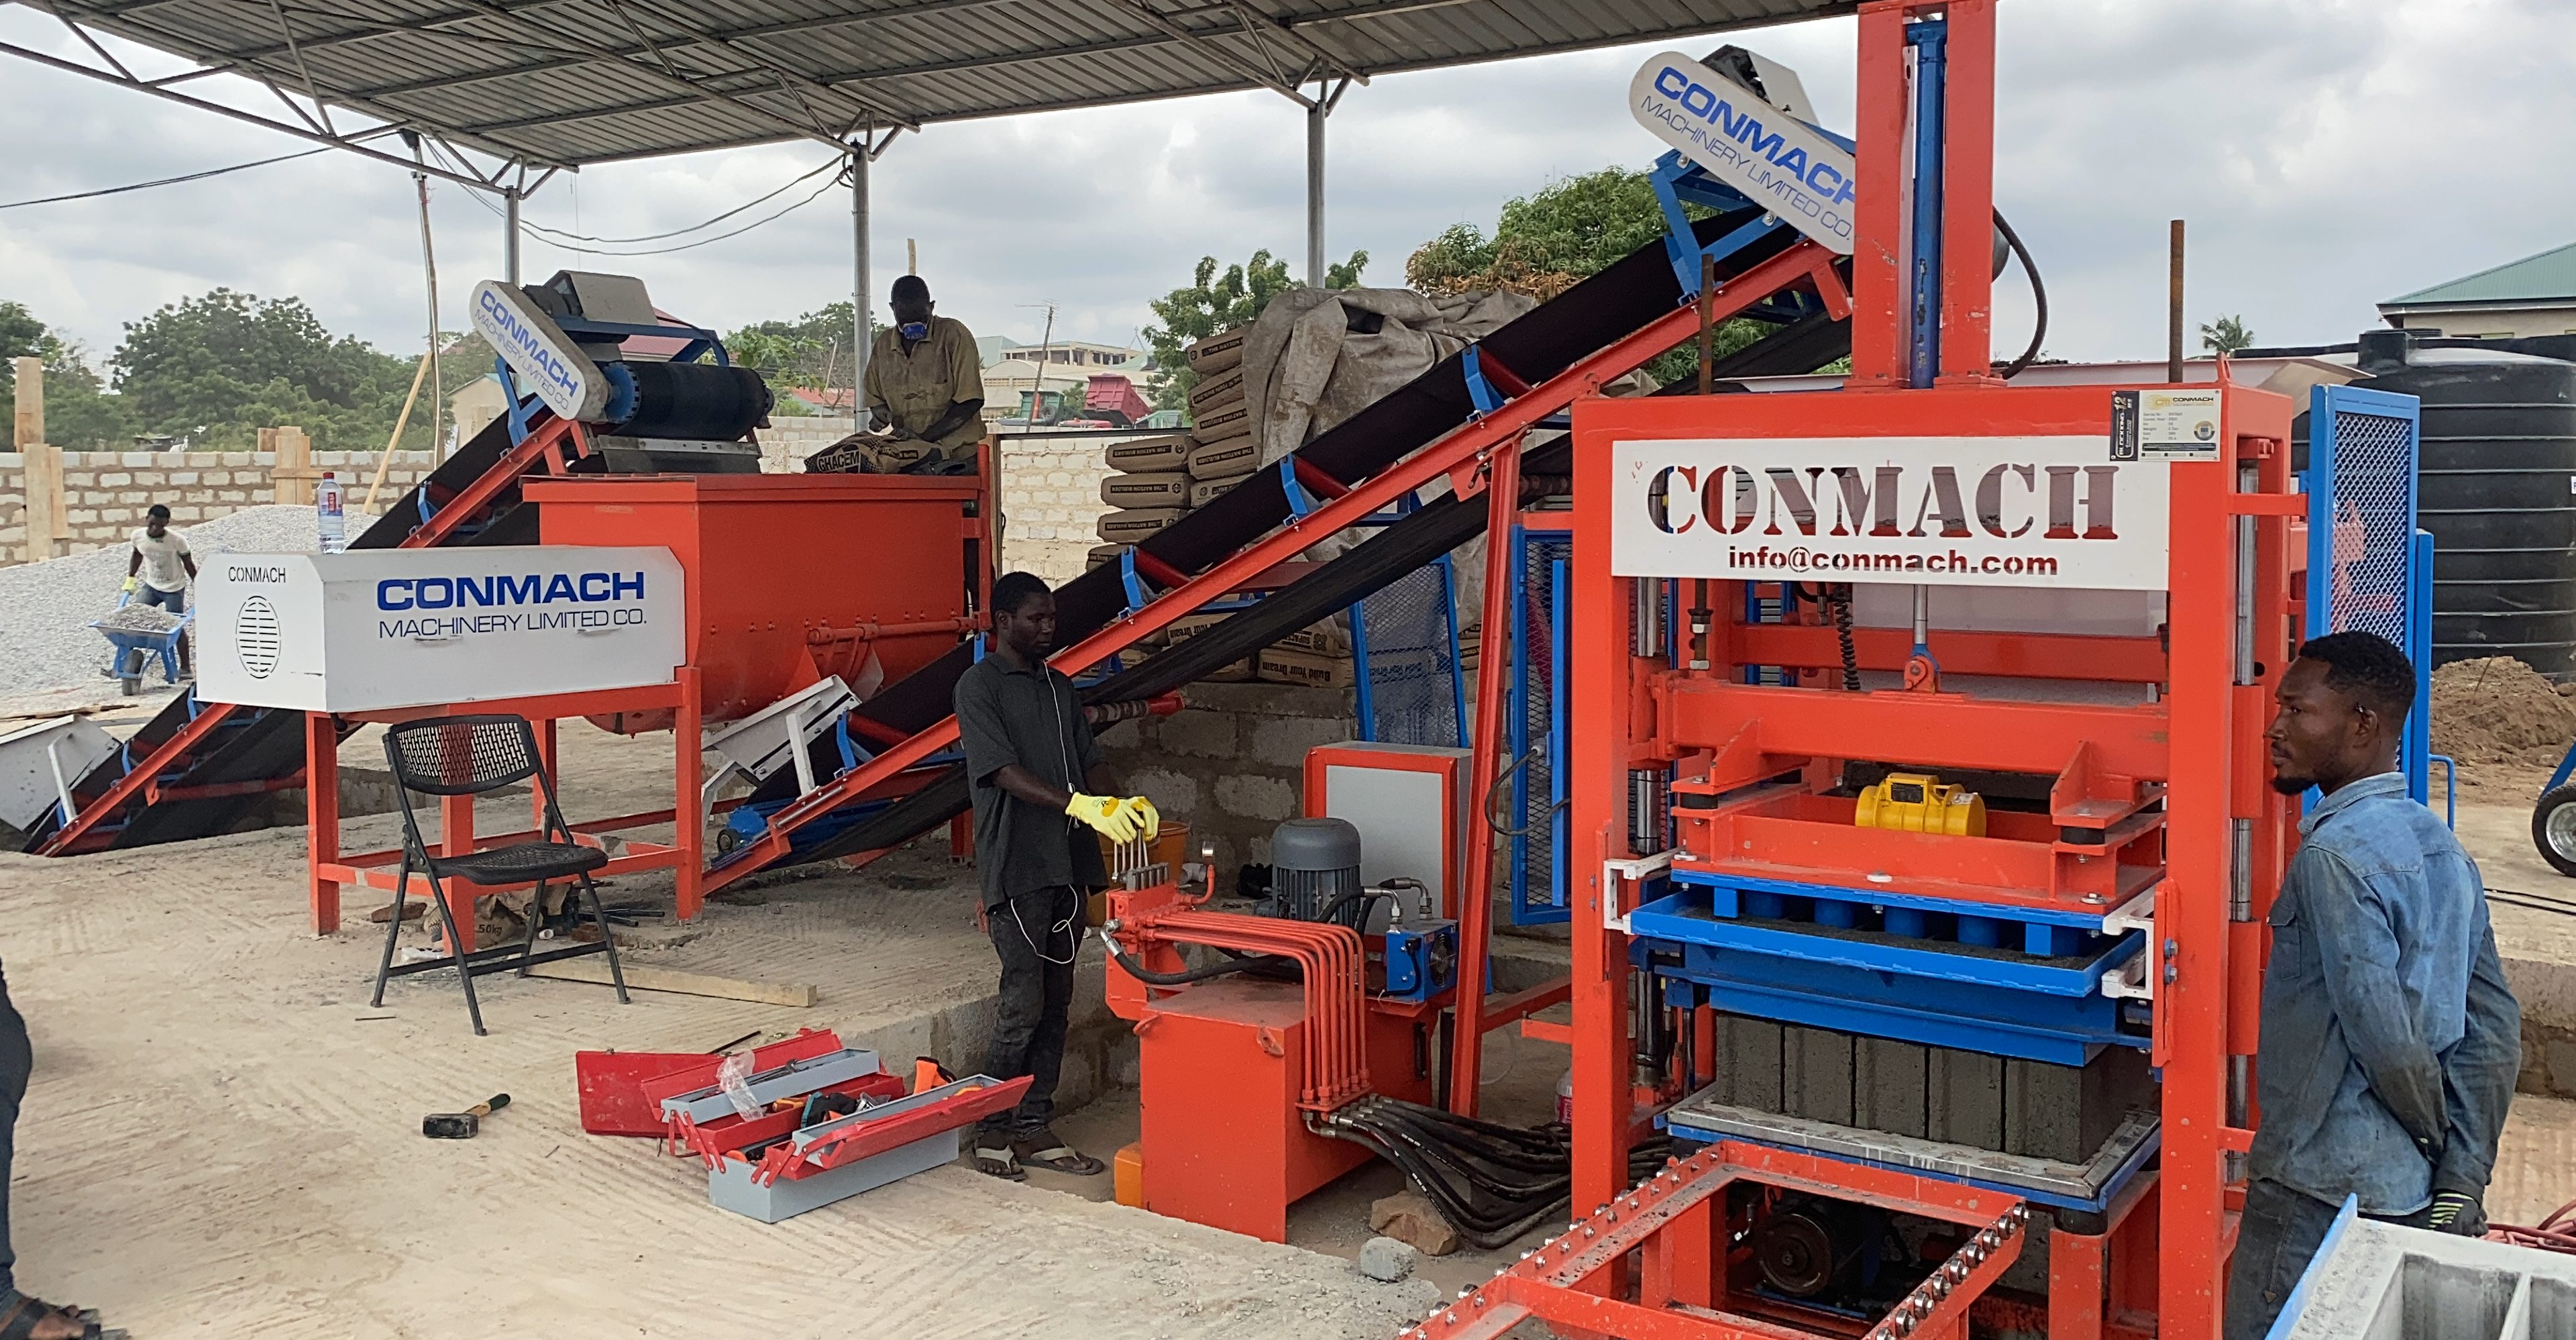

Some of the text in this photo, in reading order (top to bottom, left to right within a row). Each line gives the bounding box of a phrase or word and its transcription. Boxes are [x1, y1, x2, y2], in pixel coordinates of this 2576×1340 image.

[1641, 95, 1852, 240] MACHINERY LIMITED CO.
[475, 309, 522, 361] MACHINERY
[522, 357, 555, 396] LIMITED
[480, 290, 578, 397] CONMACH
[2114, 397, 2127, 410] 12
[818, 451, 859, 471] GHACEM
[1648, 463, 2119, 539] CONMACH
[229, 566, 286, 583] CONMACH
[1729, 546, 2057, 575] info@conmach.com
[377, 572, 644, 611] CONMACH
[380, 609, 647, 638] MACHINERY LIMITED CO.
[1263, 661, 1330, 682] Build Your Dream
[478, 924, 502, 937] 50kg
